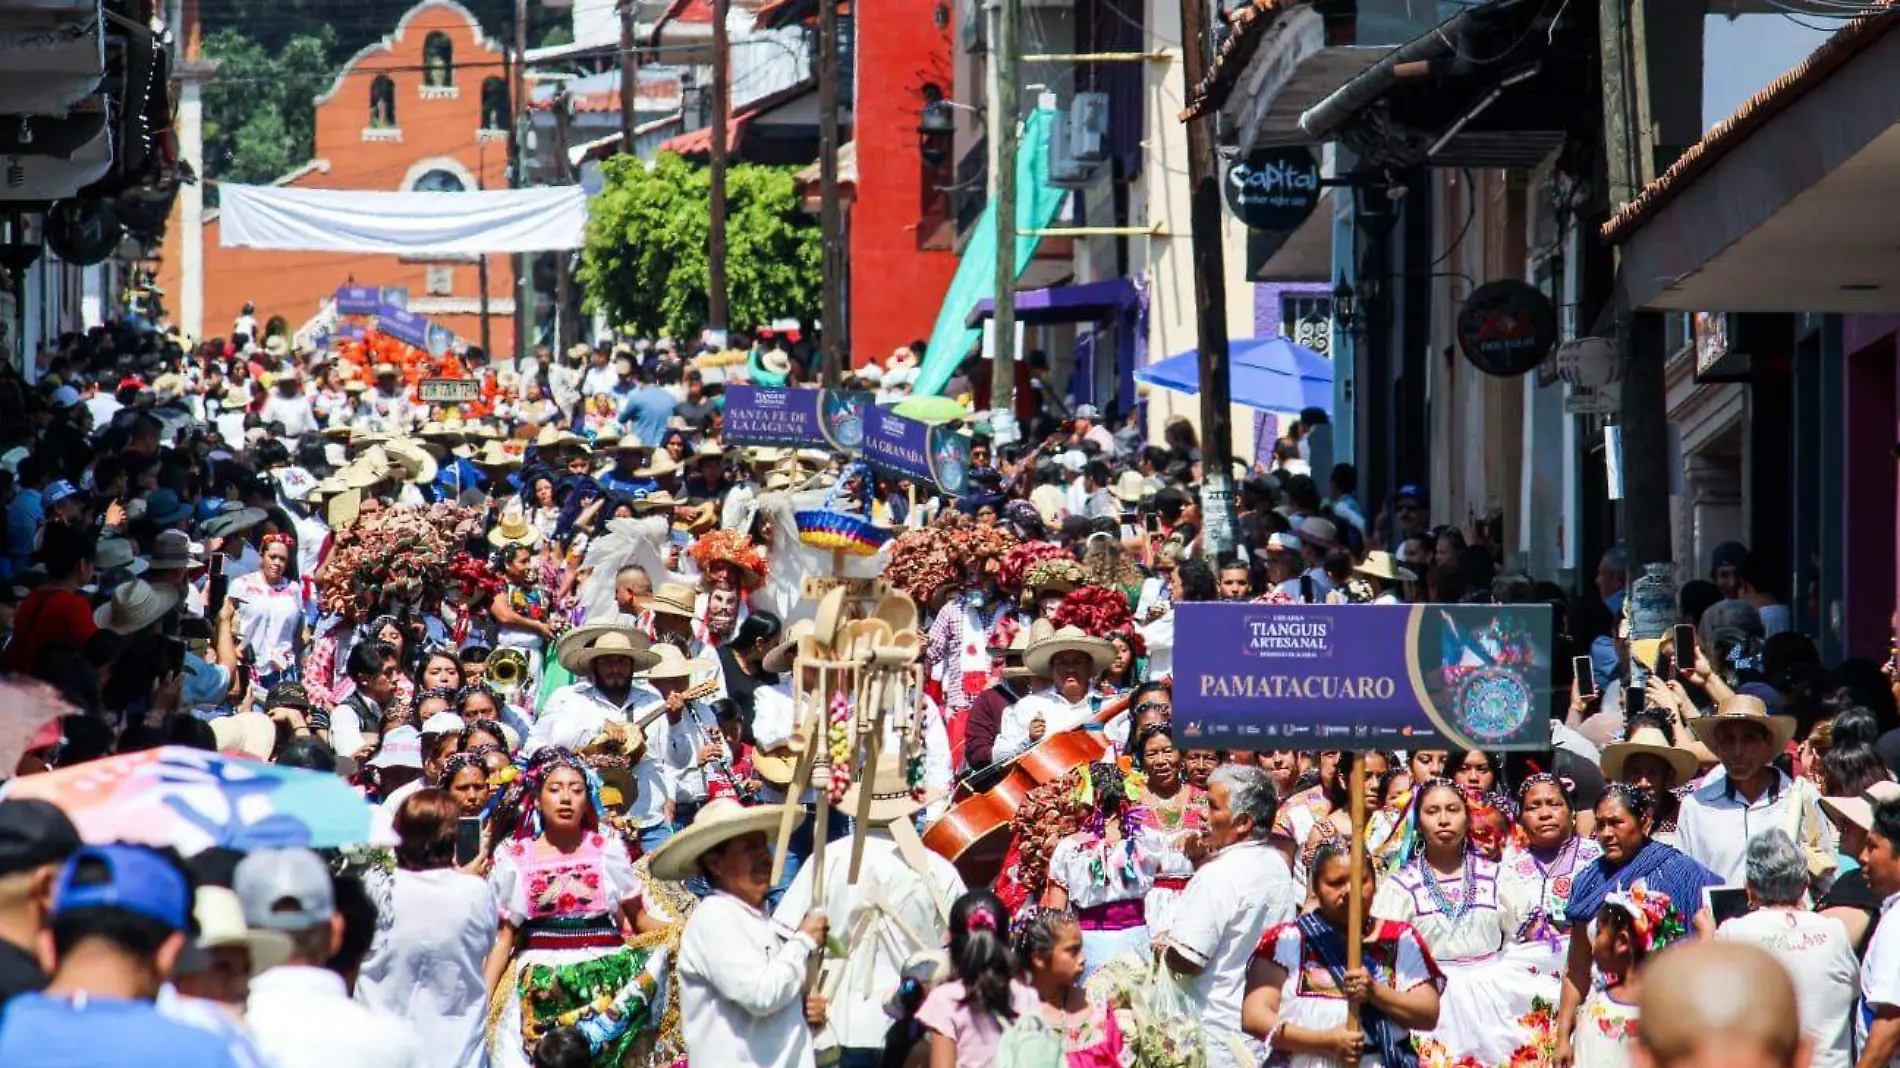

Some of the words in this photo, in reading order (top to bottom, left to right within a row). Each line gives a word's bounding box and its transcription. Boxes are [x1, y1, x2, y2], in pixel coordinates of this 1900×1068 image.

[1229, 160, 1317, 192] Capital
[729, 408, 769, 420] SANTA
[772, 411, 788, 421] FE
[791, 411, 808, 423] DE
[732, 419, 749, 431] LA
[752, 420, 803, 433] LAGUNA
[866, 435, 878, 449] LA
[879, 440, 924, 465] GRANADA
[1250, 622, 1327, 637] TIANGUIS
[1250, 637, 1327, 649] ARTESANAL
[1200, 674, 1395, 699] PAMATACUARO
